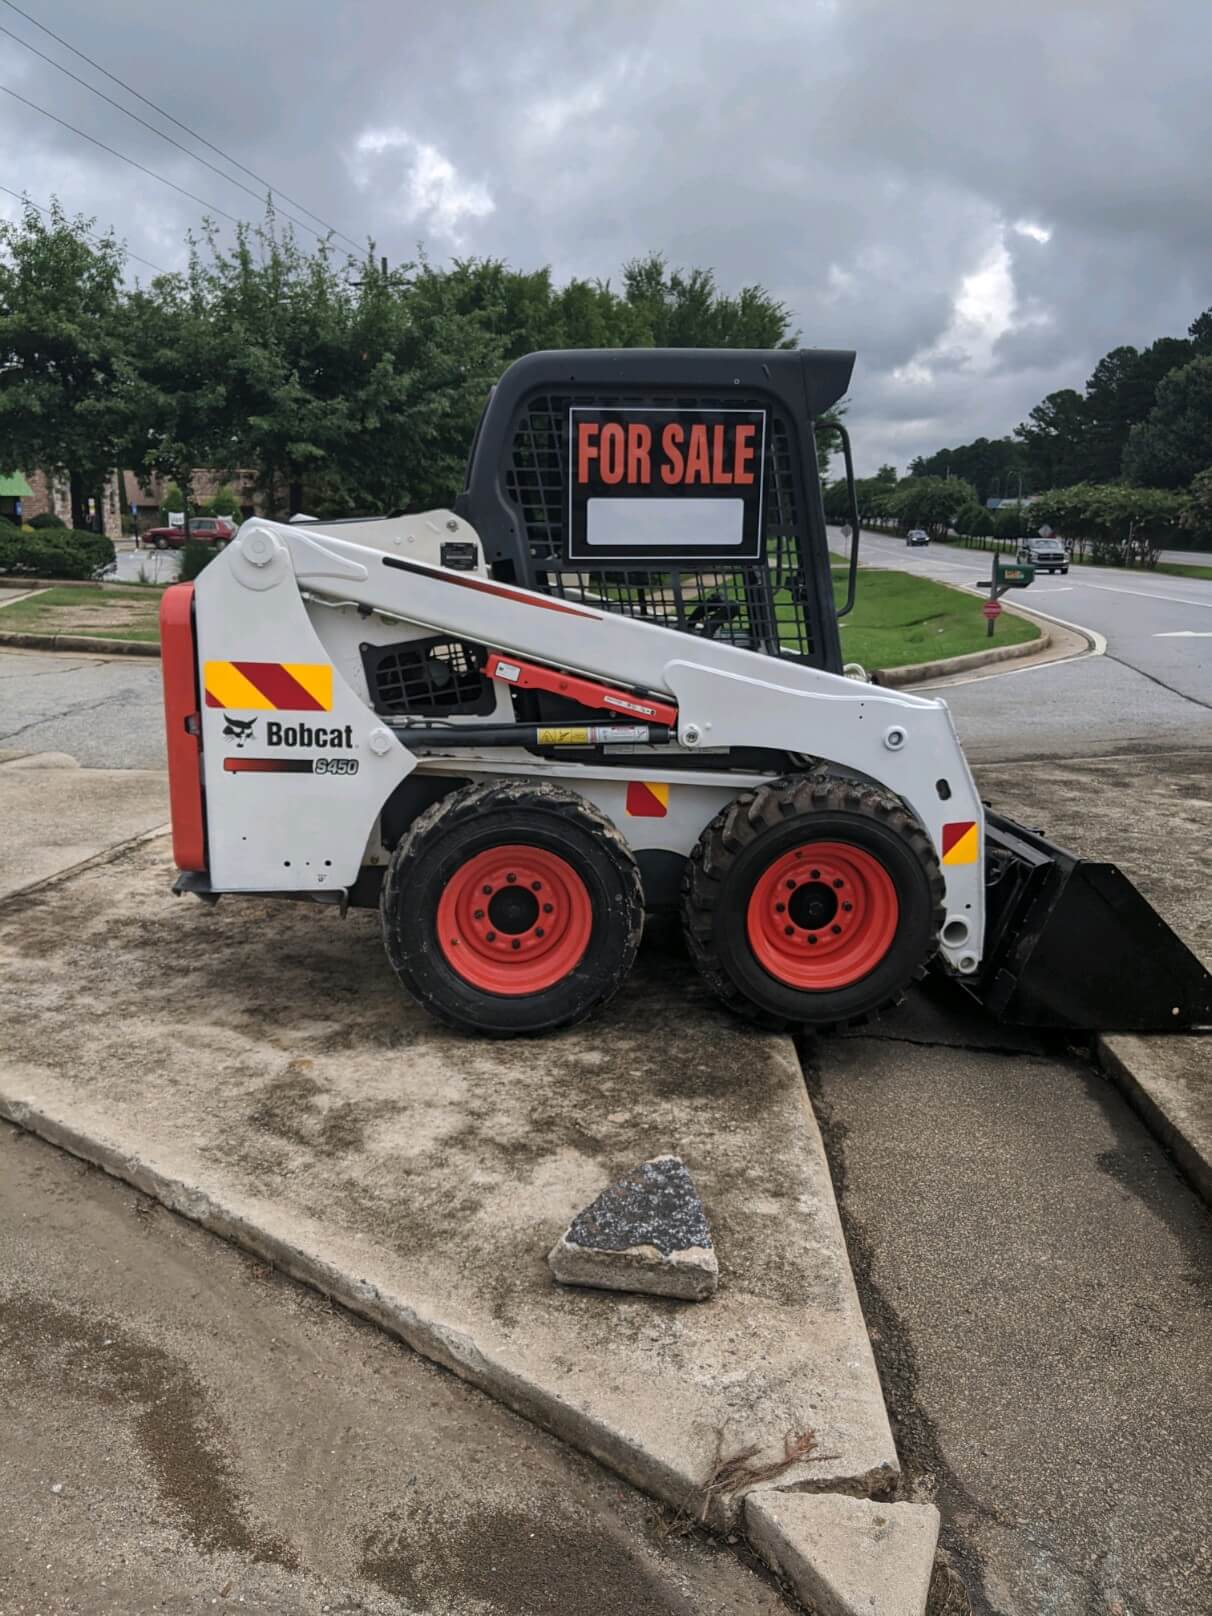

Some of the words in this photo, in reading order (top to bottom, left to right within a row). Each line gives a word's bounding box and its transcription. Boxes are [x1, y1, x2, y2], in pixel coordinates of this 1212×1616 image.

[578, 422, 652, 484] FOR
[660, 422, 756, 485] SALE
[266, 721, 353, 748] Bobcat
[314, 757, 359, 775] S450
